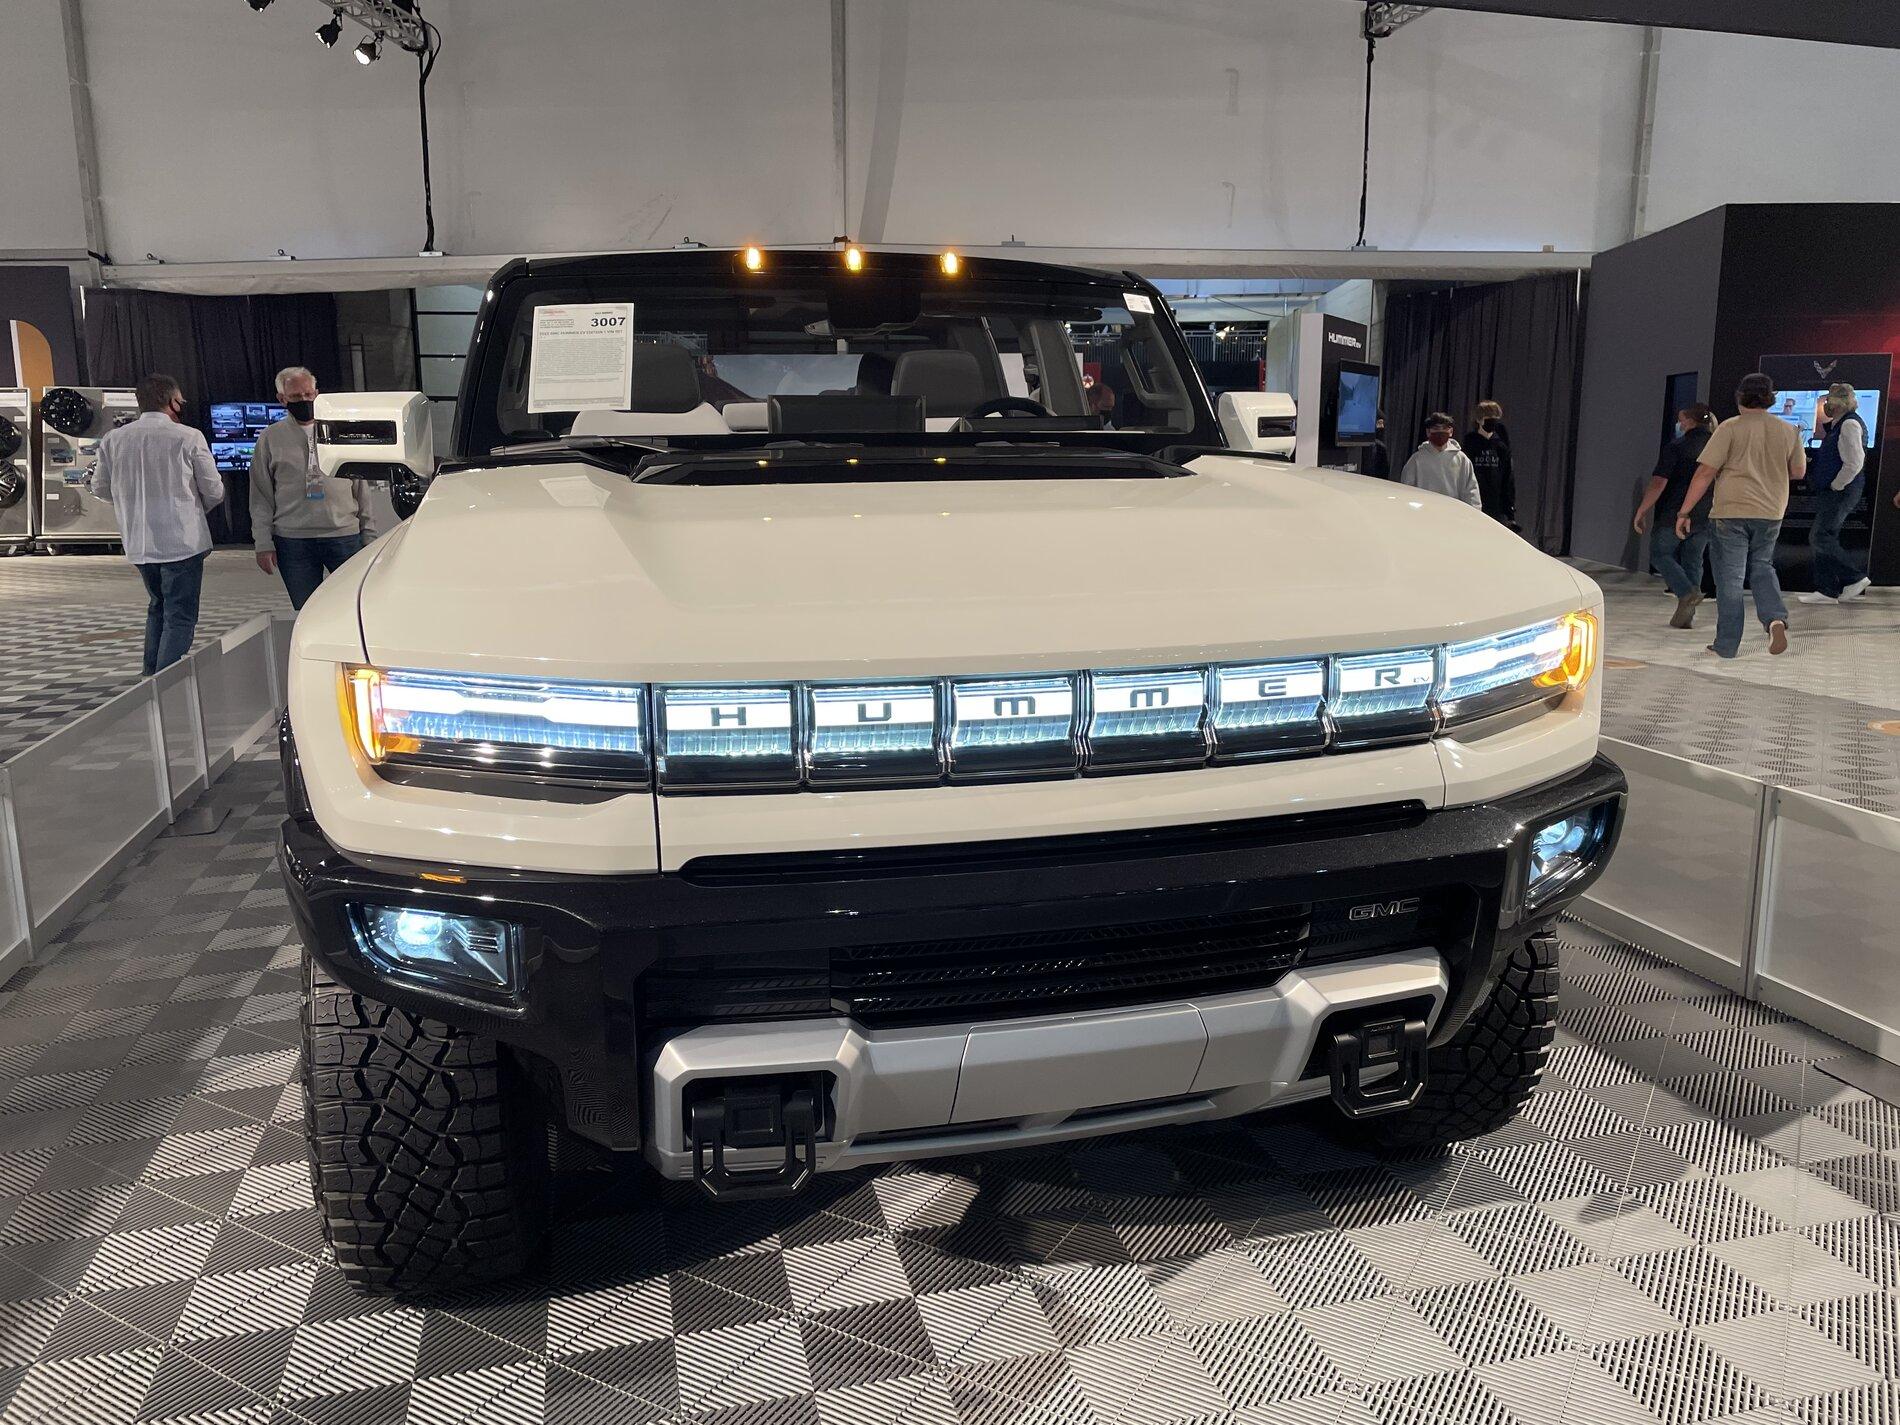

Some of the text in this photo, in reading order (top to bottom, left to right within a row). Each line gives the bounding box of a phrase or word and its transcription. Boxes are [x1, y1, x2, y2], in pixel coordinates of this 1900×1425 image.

[590, 317, 626, 327] 3007
[1328, 332, 1357, 347] HUMMER
[1349, 897, 1420, 921] GMC
